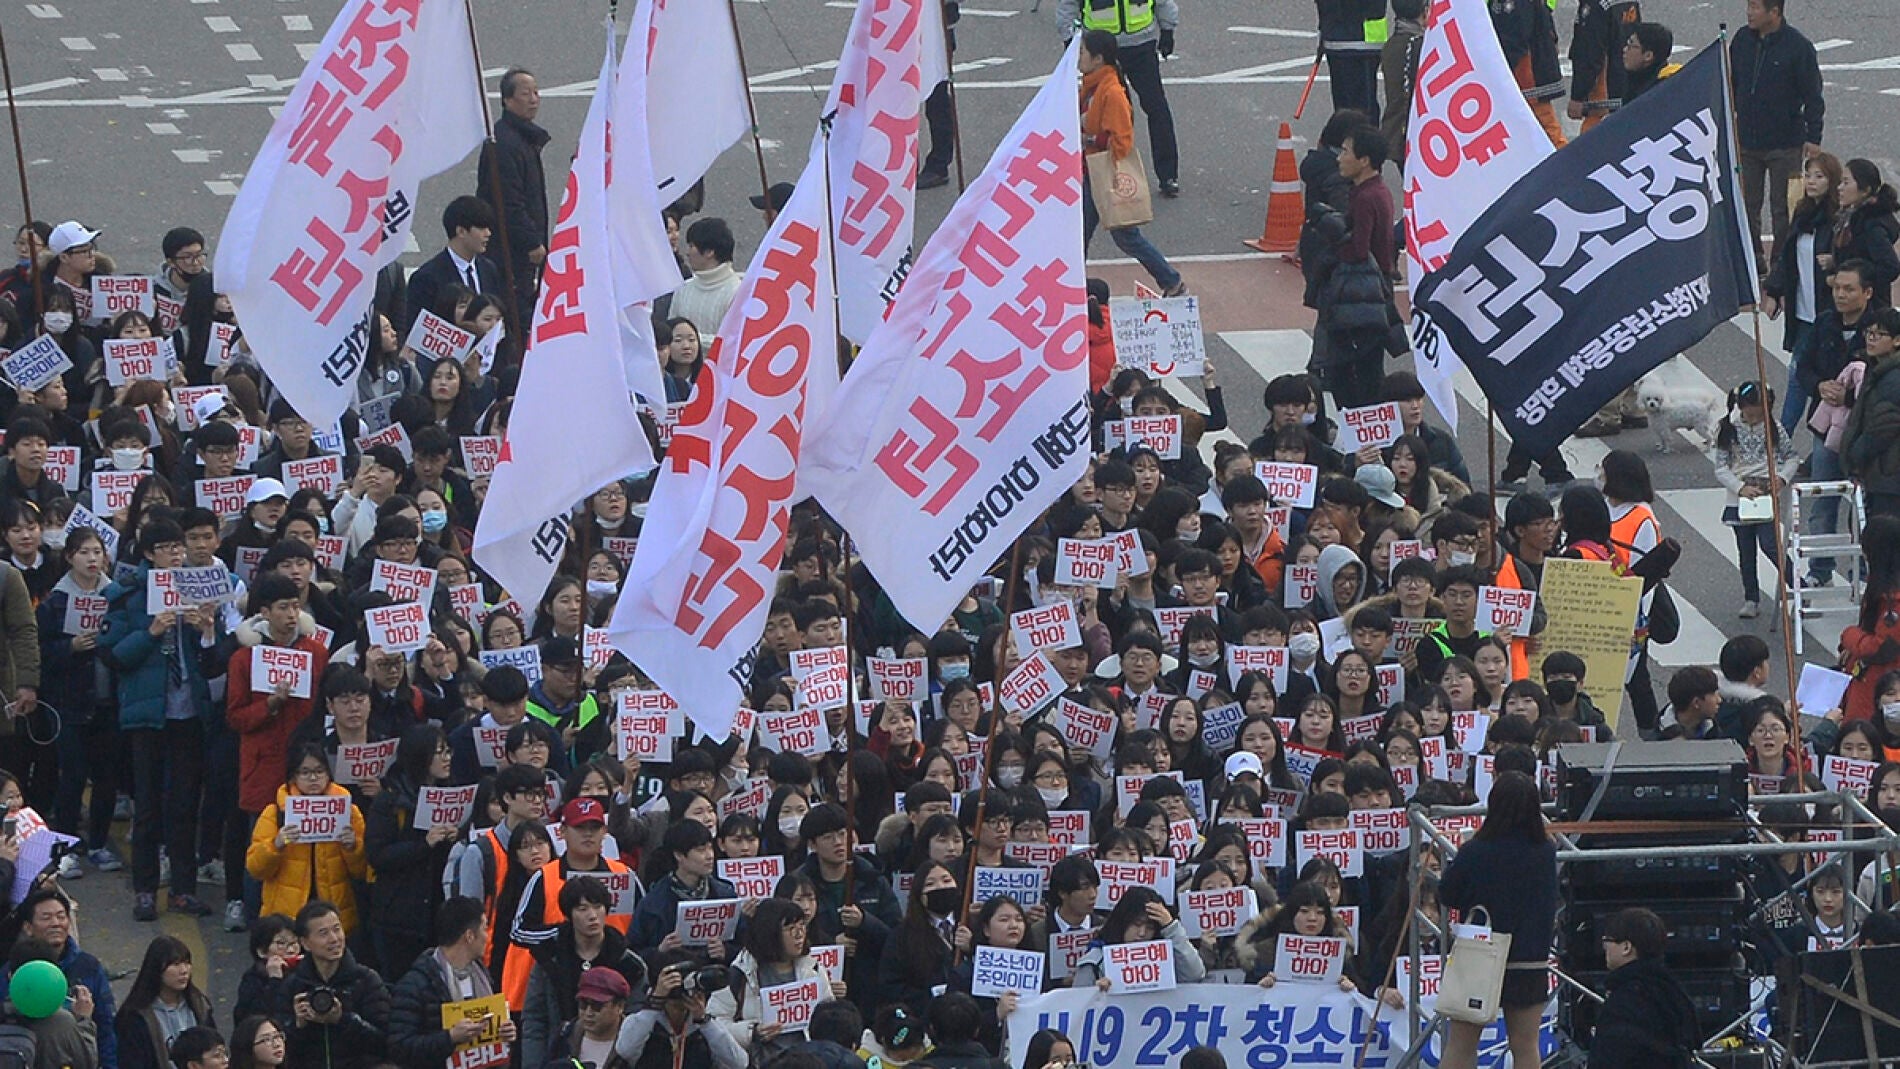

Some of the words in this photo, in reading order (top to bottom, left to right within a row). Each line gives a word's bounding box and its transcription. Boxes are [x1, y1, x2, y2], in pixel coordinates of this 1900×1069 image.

[98, 278, 148, 294] 박근혜
[107, 295, 140, 311] 하야
[110, 341, 158, 358] 박근혜
[120, 359, 152, 377] 하야
[1346, 406, 1397, 424] 박근혜
[1130, 418, 1177, 435] 박근혜
[1356, 424, 1393, 443] 하야
[47, 452, 74, 466] 근혜
[288, 460, 336, 477] 박근혜
[1262, 465, 1312, 482] 박근혜
[1269, 482, 1301, 497] 하야
[1064, 542, 1115, 561] 박근혜
[380, 564, 431, 587] 박근혜
[1071, 561, 1105, 579] 하야
[75, 597, 107, 612] 박근
[373, 606, 423, 625] 박근혜
[1016, 606, 1069, 628] 박근혜
[386, 626, 420, 644] 하야
[1030, 627, 1066, 647] 하야
[262, 649, 307, 669] 박근혜
[1234, 649, 1283, 666] 박근혜
[873, 661, 921, 677] 박근혜
[1001, 657, 1046, 699] 박근혜
[806, 684, 843, 704] 하야
[882, 680, 914, 697] 하야
[1017, 679, 1051, 709] 하야
[621, 716, 666, 734] 박근혜
[767, 709, 820, 733] 박근혜
[1062, 702, 1111, 731] 박근혜
[1204, 709, 1243, 729] 소년이
[626, 736, 657, 752] 하야
[779, 731, 815, 751] 하야
[1066, 725, 1099, 748] 하야
[345, 743, 396, 762] 박근혜
[352, 759, 385, 777] 하야
[426, 788, 474, 805] 박근혜
[292, 799, 345, 814] 박근혜
[432, 806, 463, 823] 하야
[301, 816, 336, 834] 하야
[1048, 814, 1084, 831] 근혜
[1353, 813, 1408, 830] 박근혜
[1303, 832, 1357, 850] 박근혜
[1363, 831, 1400, 849] 하야
[725, 862, 778, 879] 박근혜
[977, 871, 1040, 888] 청소년이
[1100, 865, 1155, 884] 박근혜
[736, 880, 771, 898] 하야
[1188, 891, 1243, 909] 박근혜
[684, 904, 736, 921] 박근혜
[1199, 911, 1237, 930] 하야
[690, 922, 725, 938] 하야
[1111, 944, 1167, 963] 박근혜
[1285, 937, 1339, 957] 박근혜
[979, 951, 1040, 972] 청소년이
[1292, 958, 1328, 976] 하야
[979, 971, 1038, 990] 주인이다
[1121, 965, 1160, 984] 하야
[769, 983, 817, 1006] 박근혜
[778, 1006, 810, 1025] 하야
[1135, 1004, 1227, 1064] 2차
[1240, 1004, 1392, 1067] 청소년
